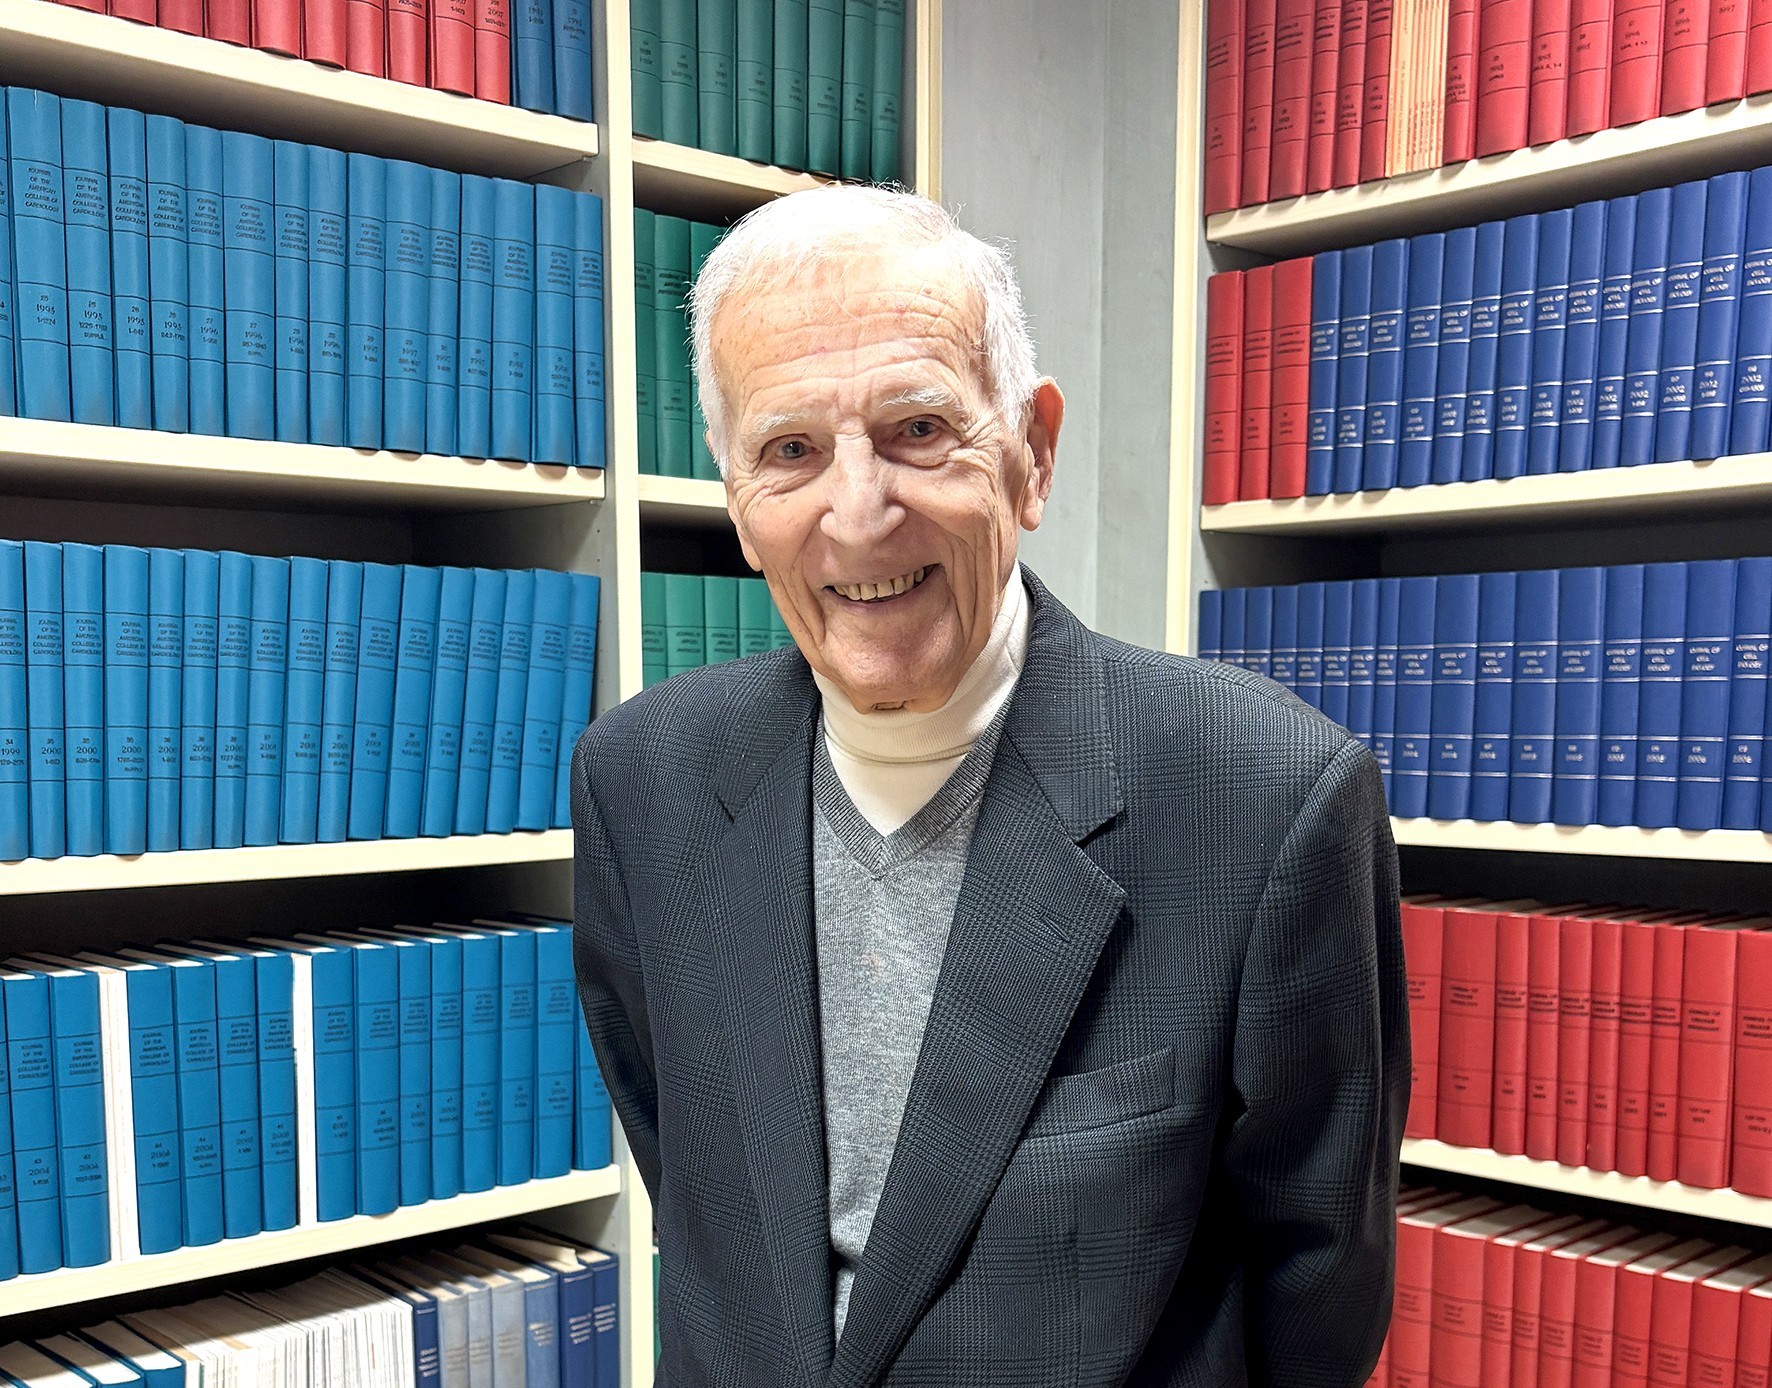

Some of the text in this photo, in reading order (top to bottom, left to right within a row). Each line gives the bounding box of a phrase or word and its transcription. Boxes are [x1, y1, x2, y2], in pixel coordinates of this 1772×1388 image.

[36, 303, 55, 314] 1995
[84, 310, 103, 321] 1995
[127, 316, 145, 326] 1995
[164, 321, 182, 330] 1995
[1, 747, 21, 756] 1999
[76, 746, 98, 754] 2000
[121, 746, 142, 754] 2000
